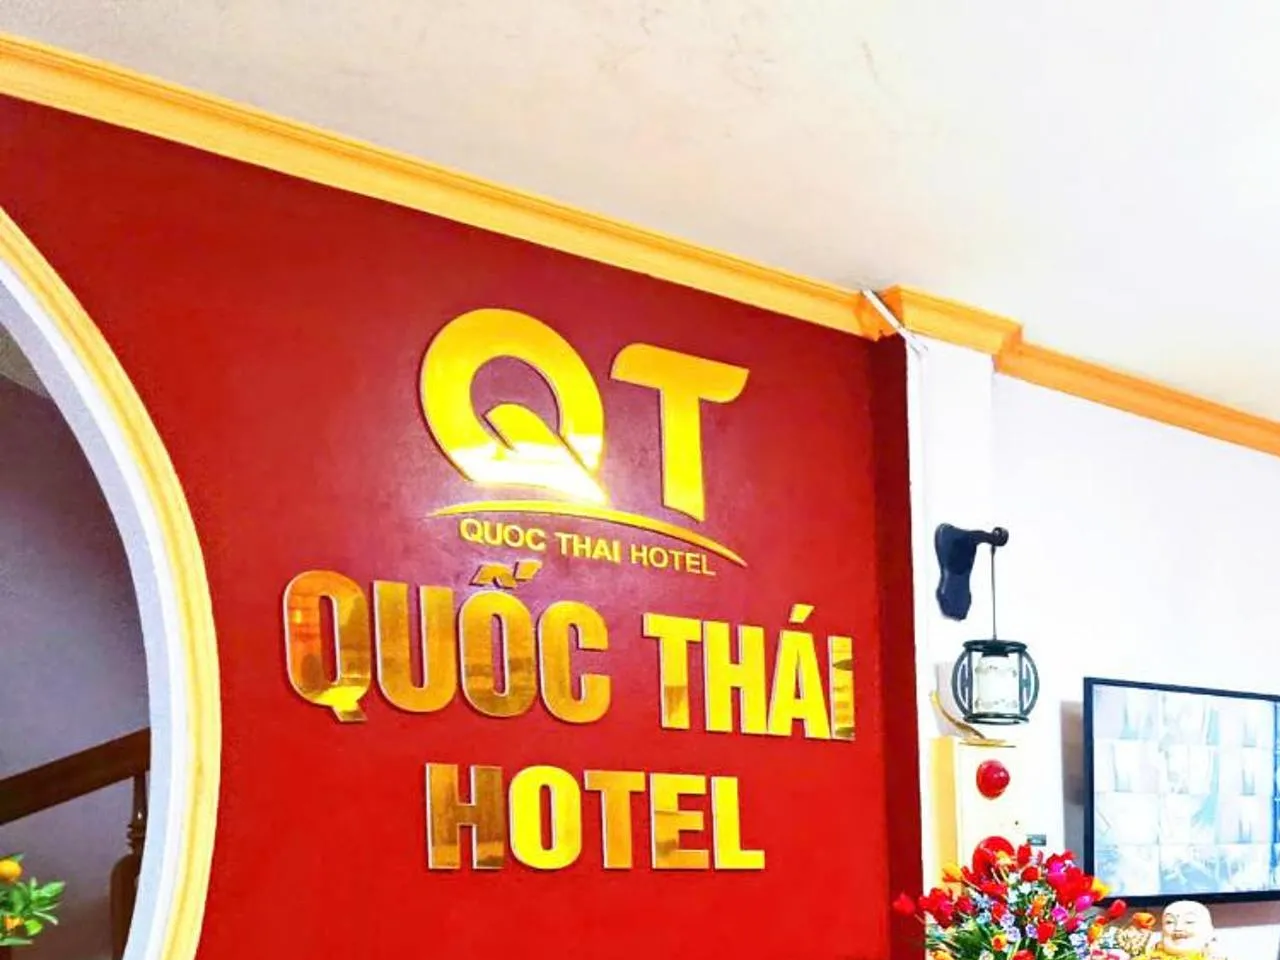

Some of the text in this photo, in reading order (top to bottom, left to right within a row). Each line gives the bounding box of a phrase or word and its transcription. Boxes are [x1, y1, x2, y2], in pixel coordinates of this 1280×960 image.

[420, 308, 751, 522] QT
[459, 518, 717, 577] QUOC THAI HOTEL
[283, 559, 855, 742] QUỐC THÁI
[424, 762, 767, 871] HOTEL
